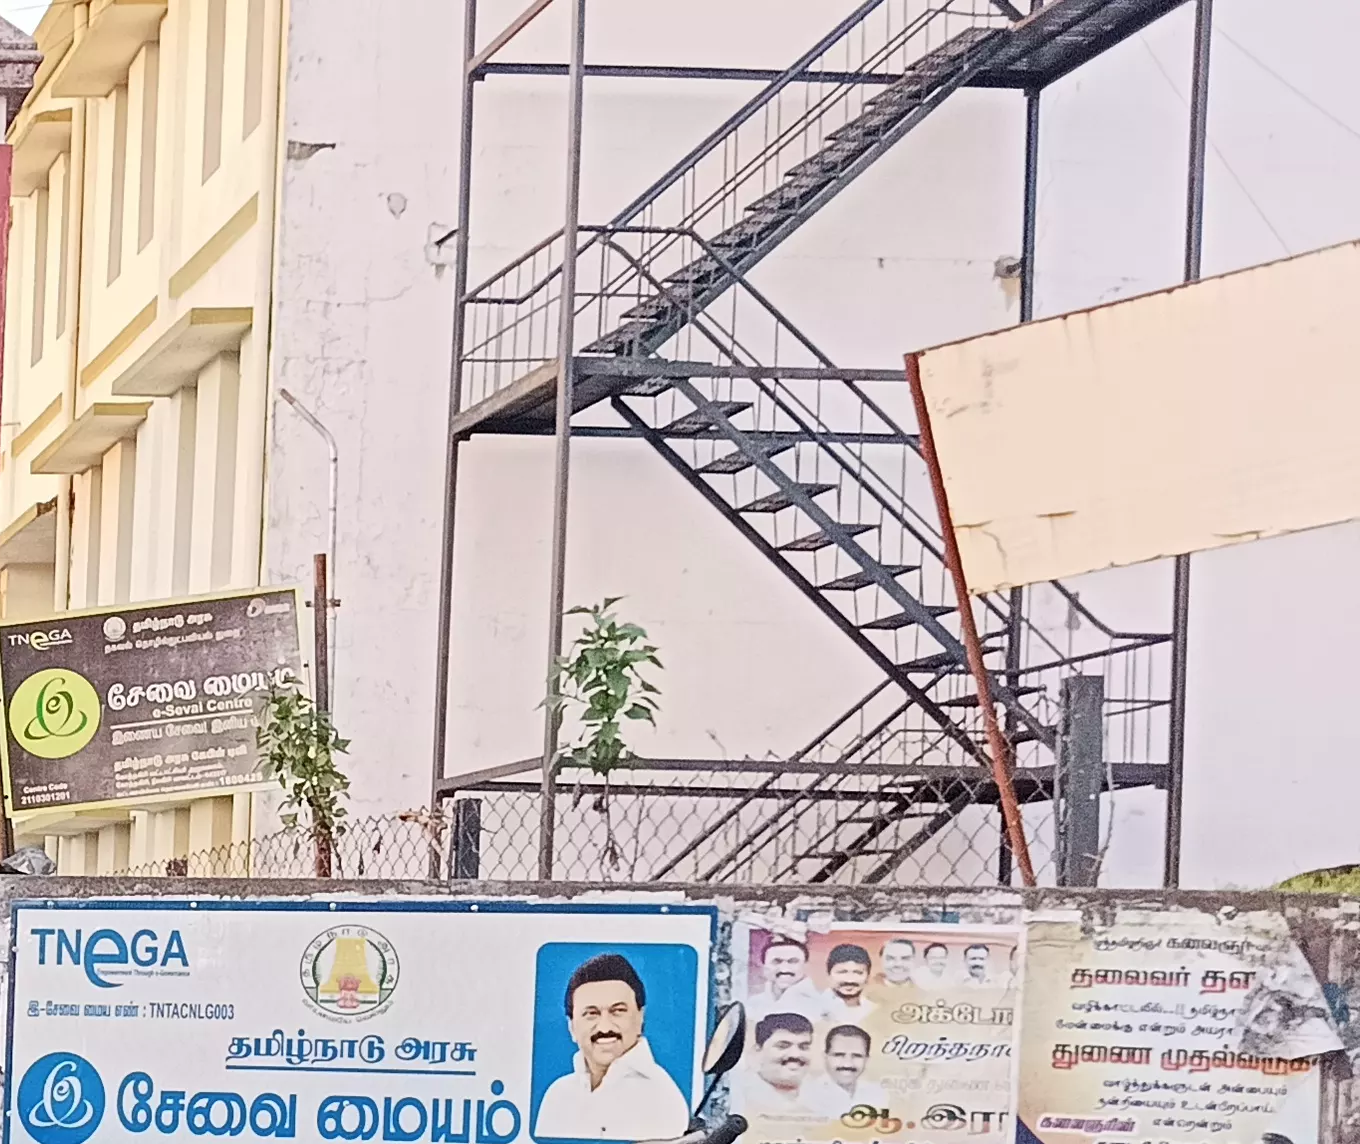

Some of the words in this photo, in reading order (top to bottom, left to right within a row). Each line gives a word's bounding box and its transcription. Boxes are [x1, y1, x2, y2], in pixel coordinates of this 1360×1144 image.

[108, 680, 197, 711] சேவை
[1069, 965, 1192, 990] தலைவர்
[225, 1029, 386, 1065] தமிழ்நாடு
[394, 1037, 478, 1065] அரசு
[1051, 1042, 1153, 1070] துணை
[117, 1071, 298, 1138] சேவை
[317, 1079, 522, 1144] மையம்
